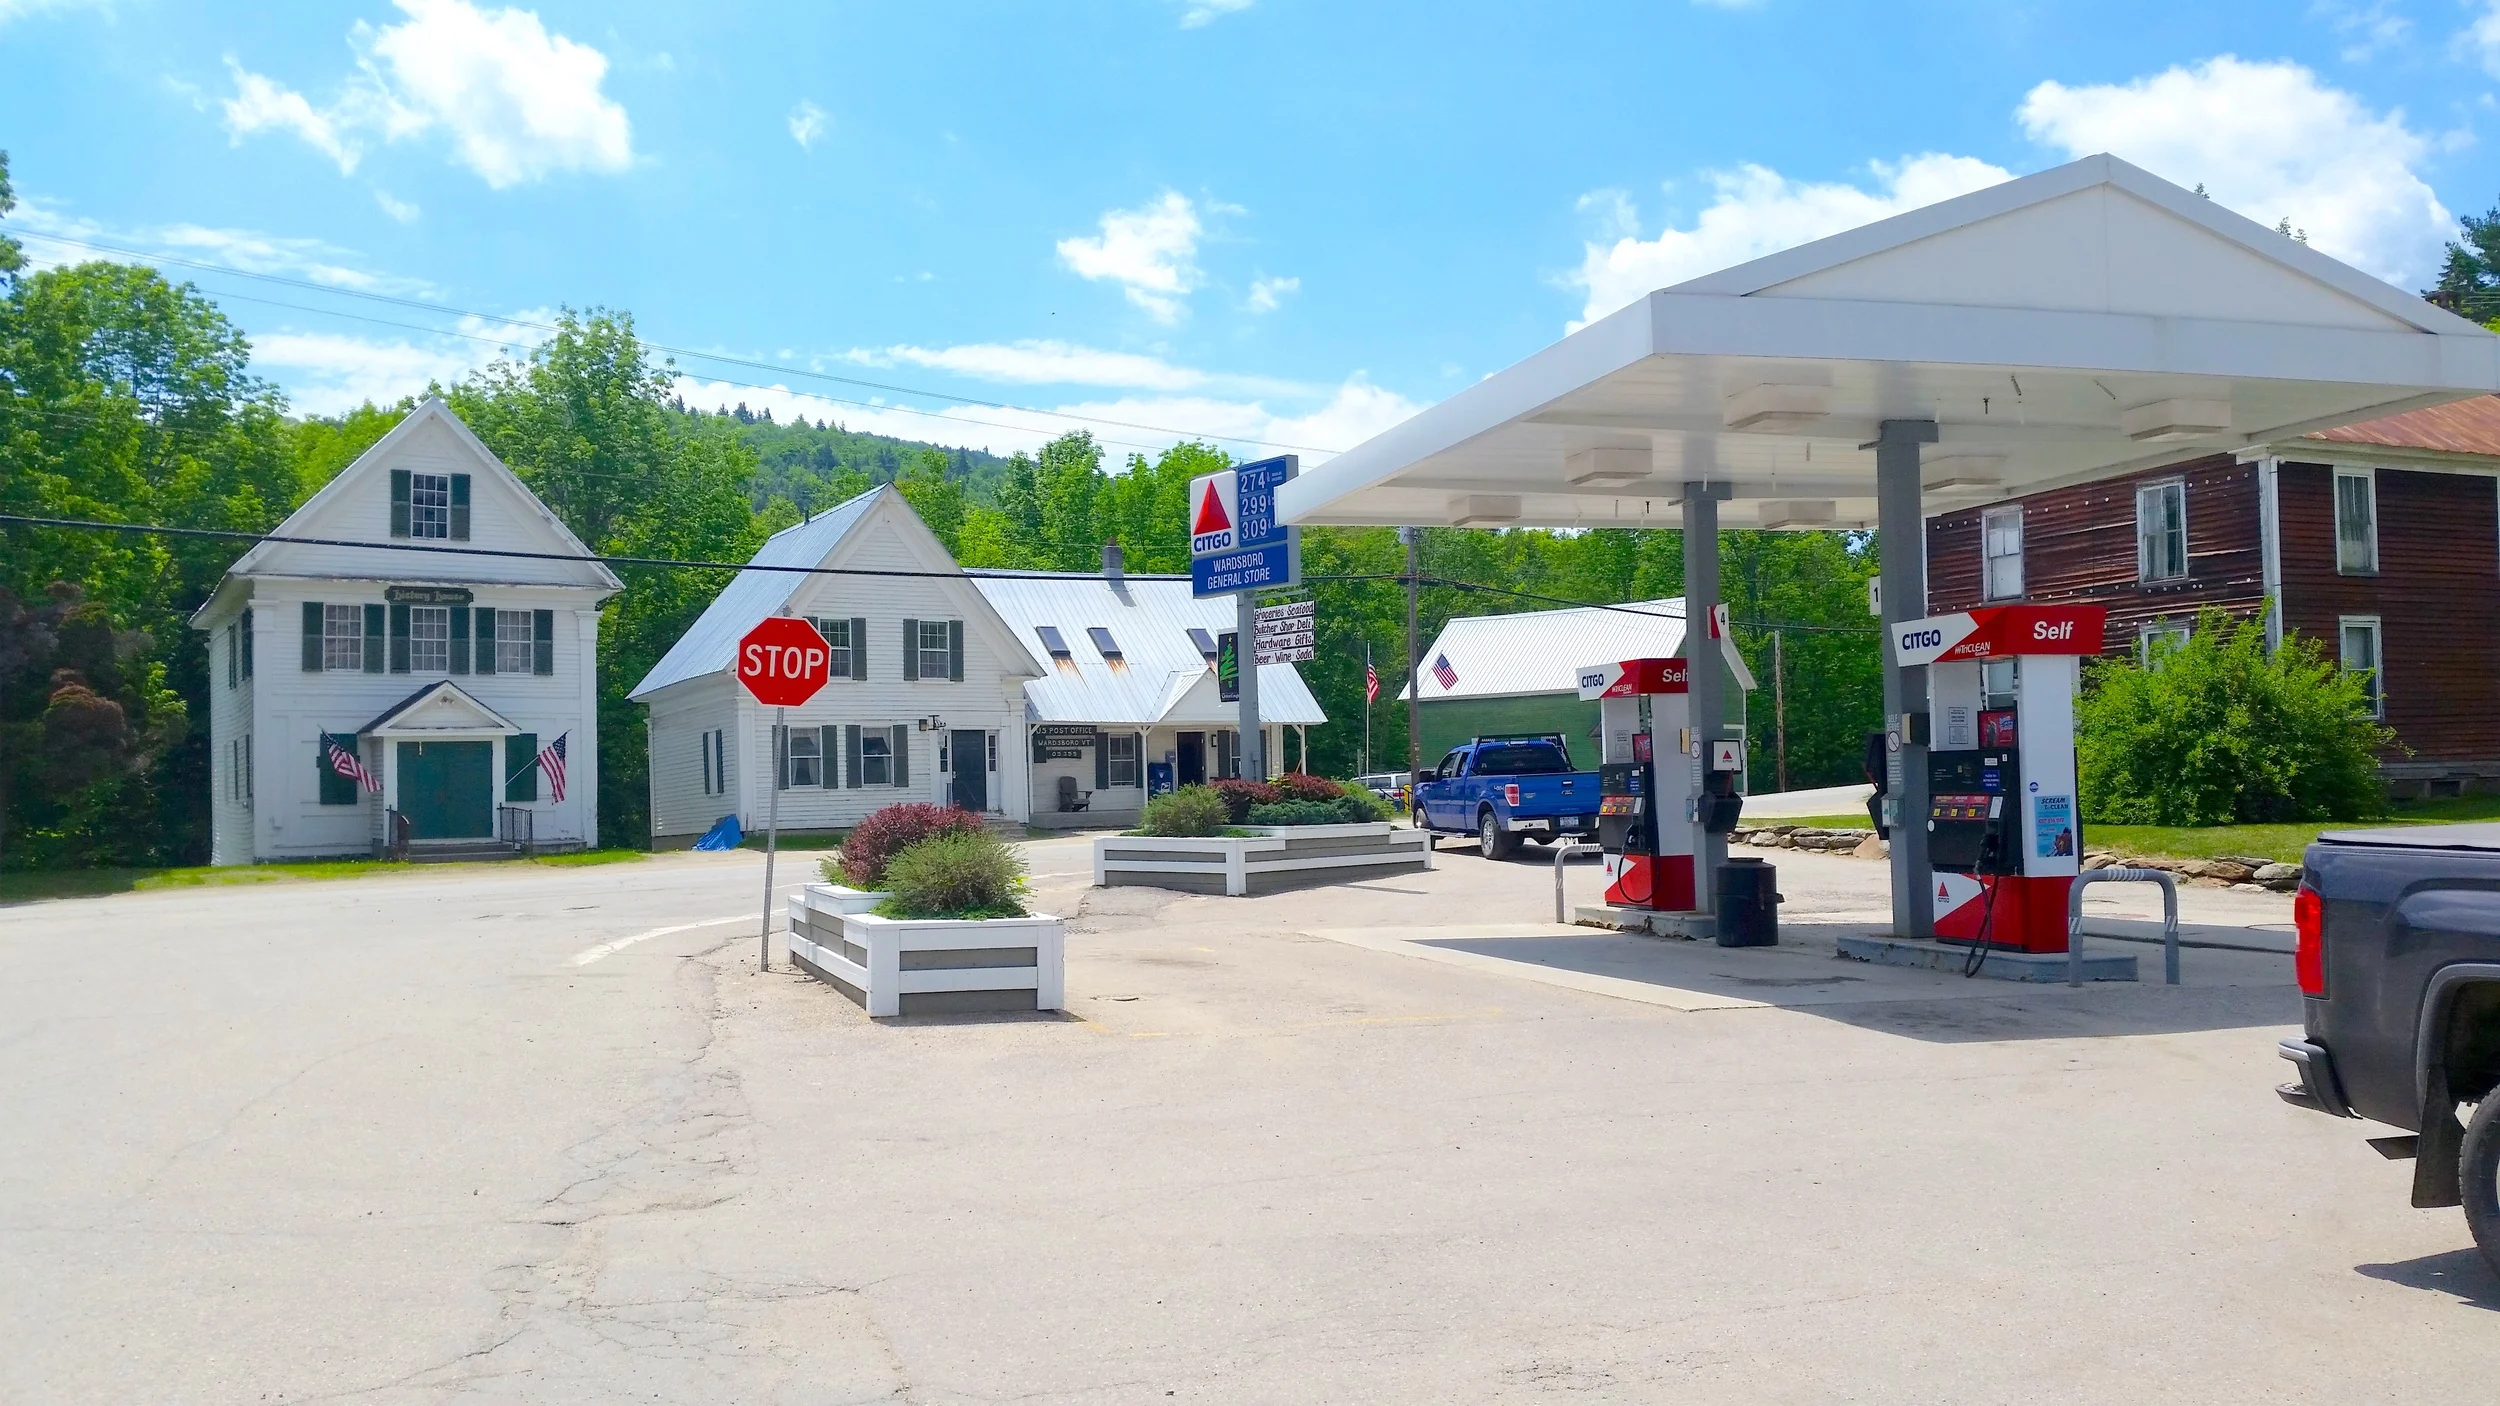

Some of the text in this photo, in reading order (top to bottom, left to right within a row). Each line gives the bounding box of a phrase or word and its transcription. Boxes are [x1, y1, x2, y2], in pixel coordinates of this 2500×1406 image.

[1241, 472, 1265, 493] 274
[1242, 495, 1267, 516] 299
[1242, 518, 1267, 540] 309
[1194, 532, 1232, 552] CITGO
[1213, 552, 1264, 573] WARDSBORO
[1207, 567, 1270, 590] GENERAL STORE
[1873, 586, 1879, 603] 1
[1254, 602, 1314, 621] Groceries Seafood
[1720, 612, 1726, 626] 4
[1254, 618, 1311, 635] Butcher Shop Deli
[2033, 620, 2074, 640] Self
[1255, 633, 1312, 650] Hardware Gifts
[1902, 629, 1941, 650] CITGO
[743, 643, 824, 680] STOP
[1254, 648, 1313, 665] Beer Wine Soda
[1581, 673, 1604, 688] CITGO
